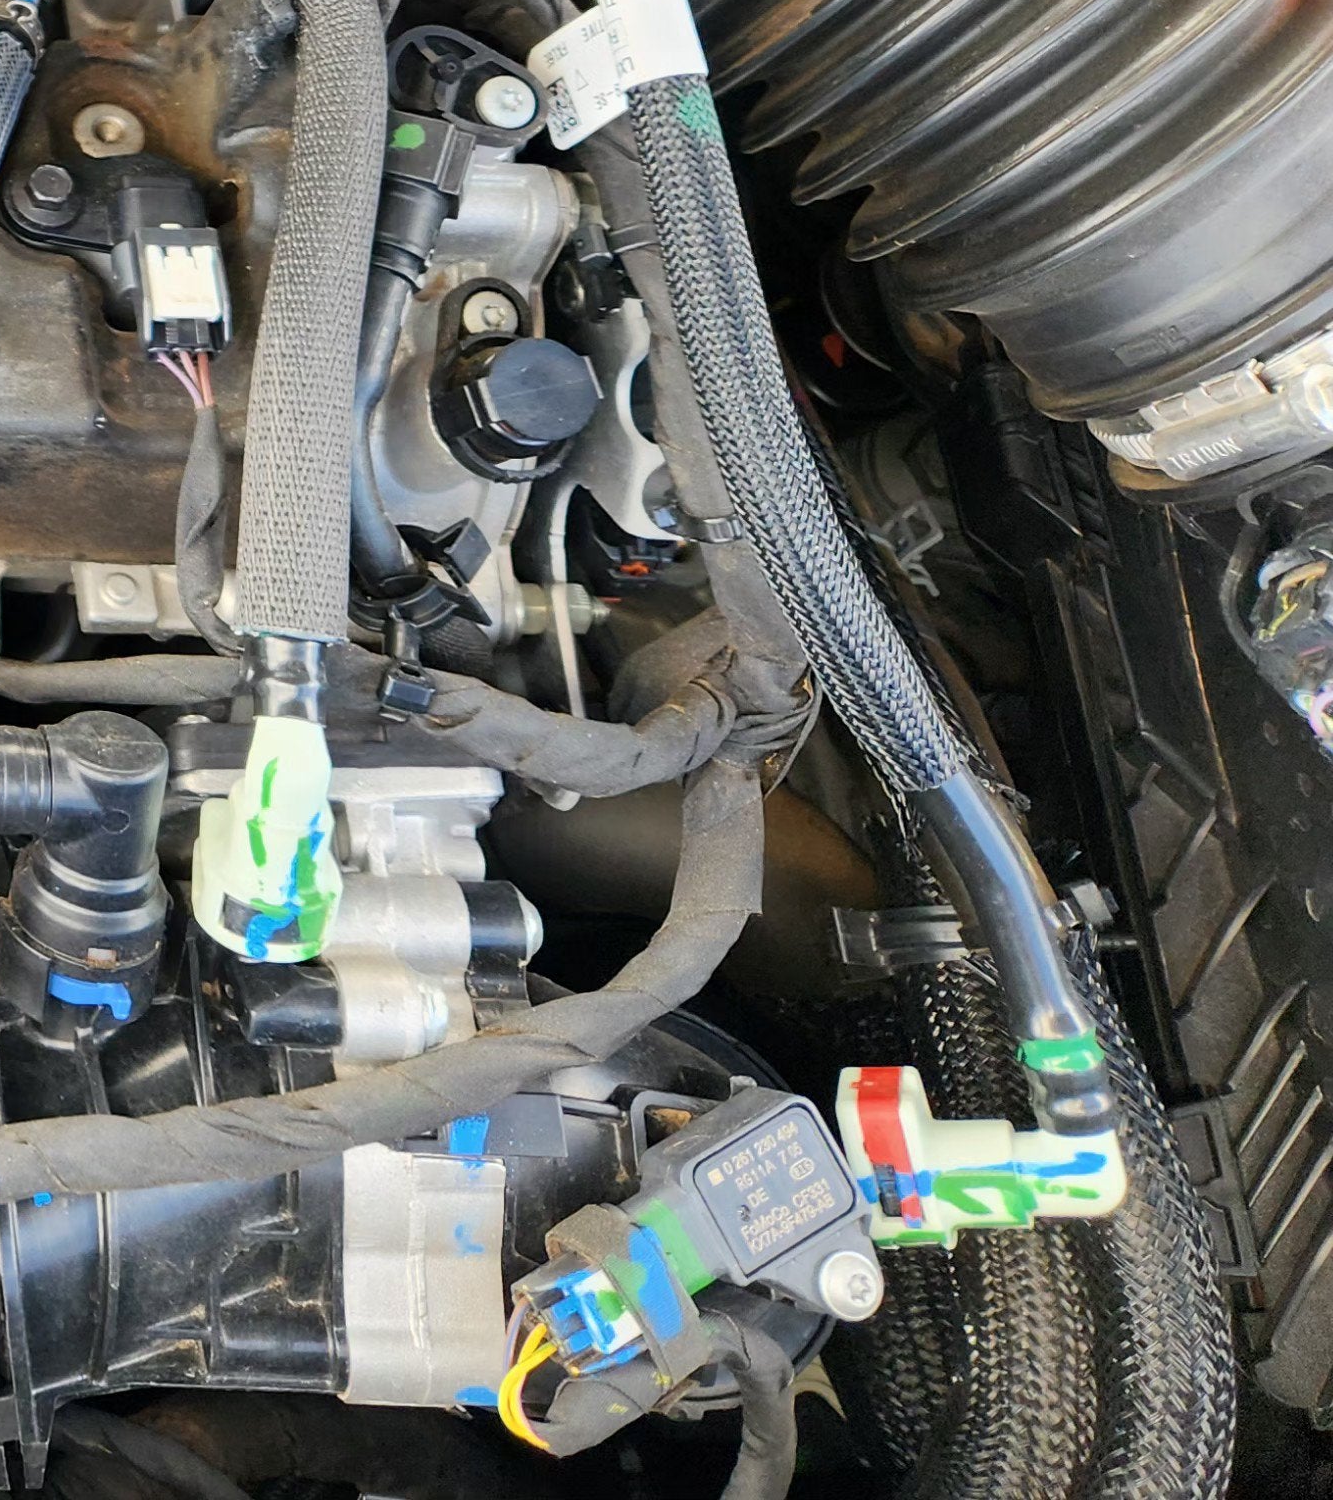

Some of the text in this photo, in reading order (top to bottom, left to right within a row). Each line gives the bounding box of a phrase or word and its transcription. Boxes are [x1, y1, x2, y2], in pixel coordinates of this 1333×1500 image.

[1167, 437, 1243, 470] TRIDON
[732, 1149, 754, 1169] 261
[754, 1138, 775, 1156] 230
[748, 1188, 768, 1207] DE
[741, 1206, 789, 1240] FoMoCo
